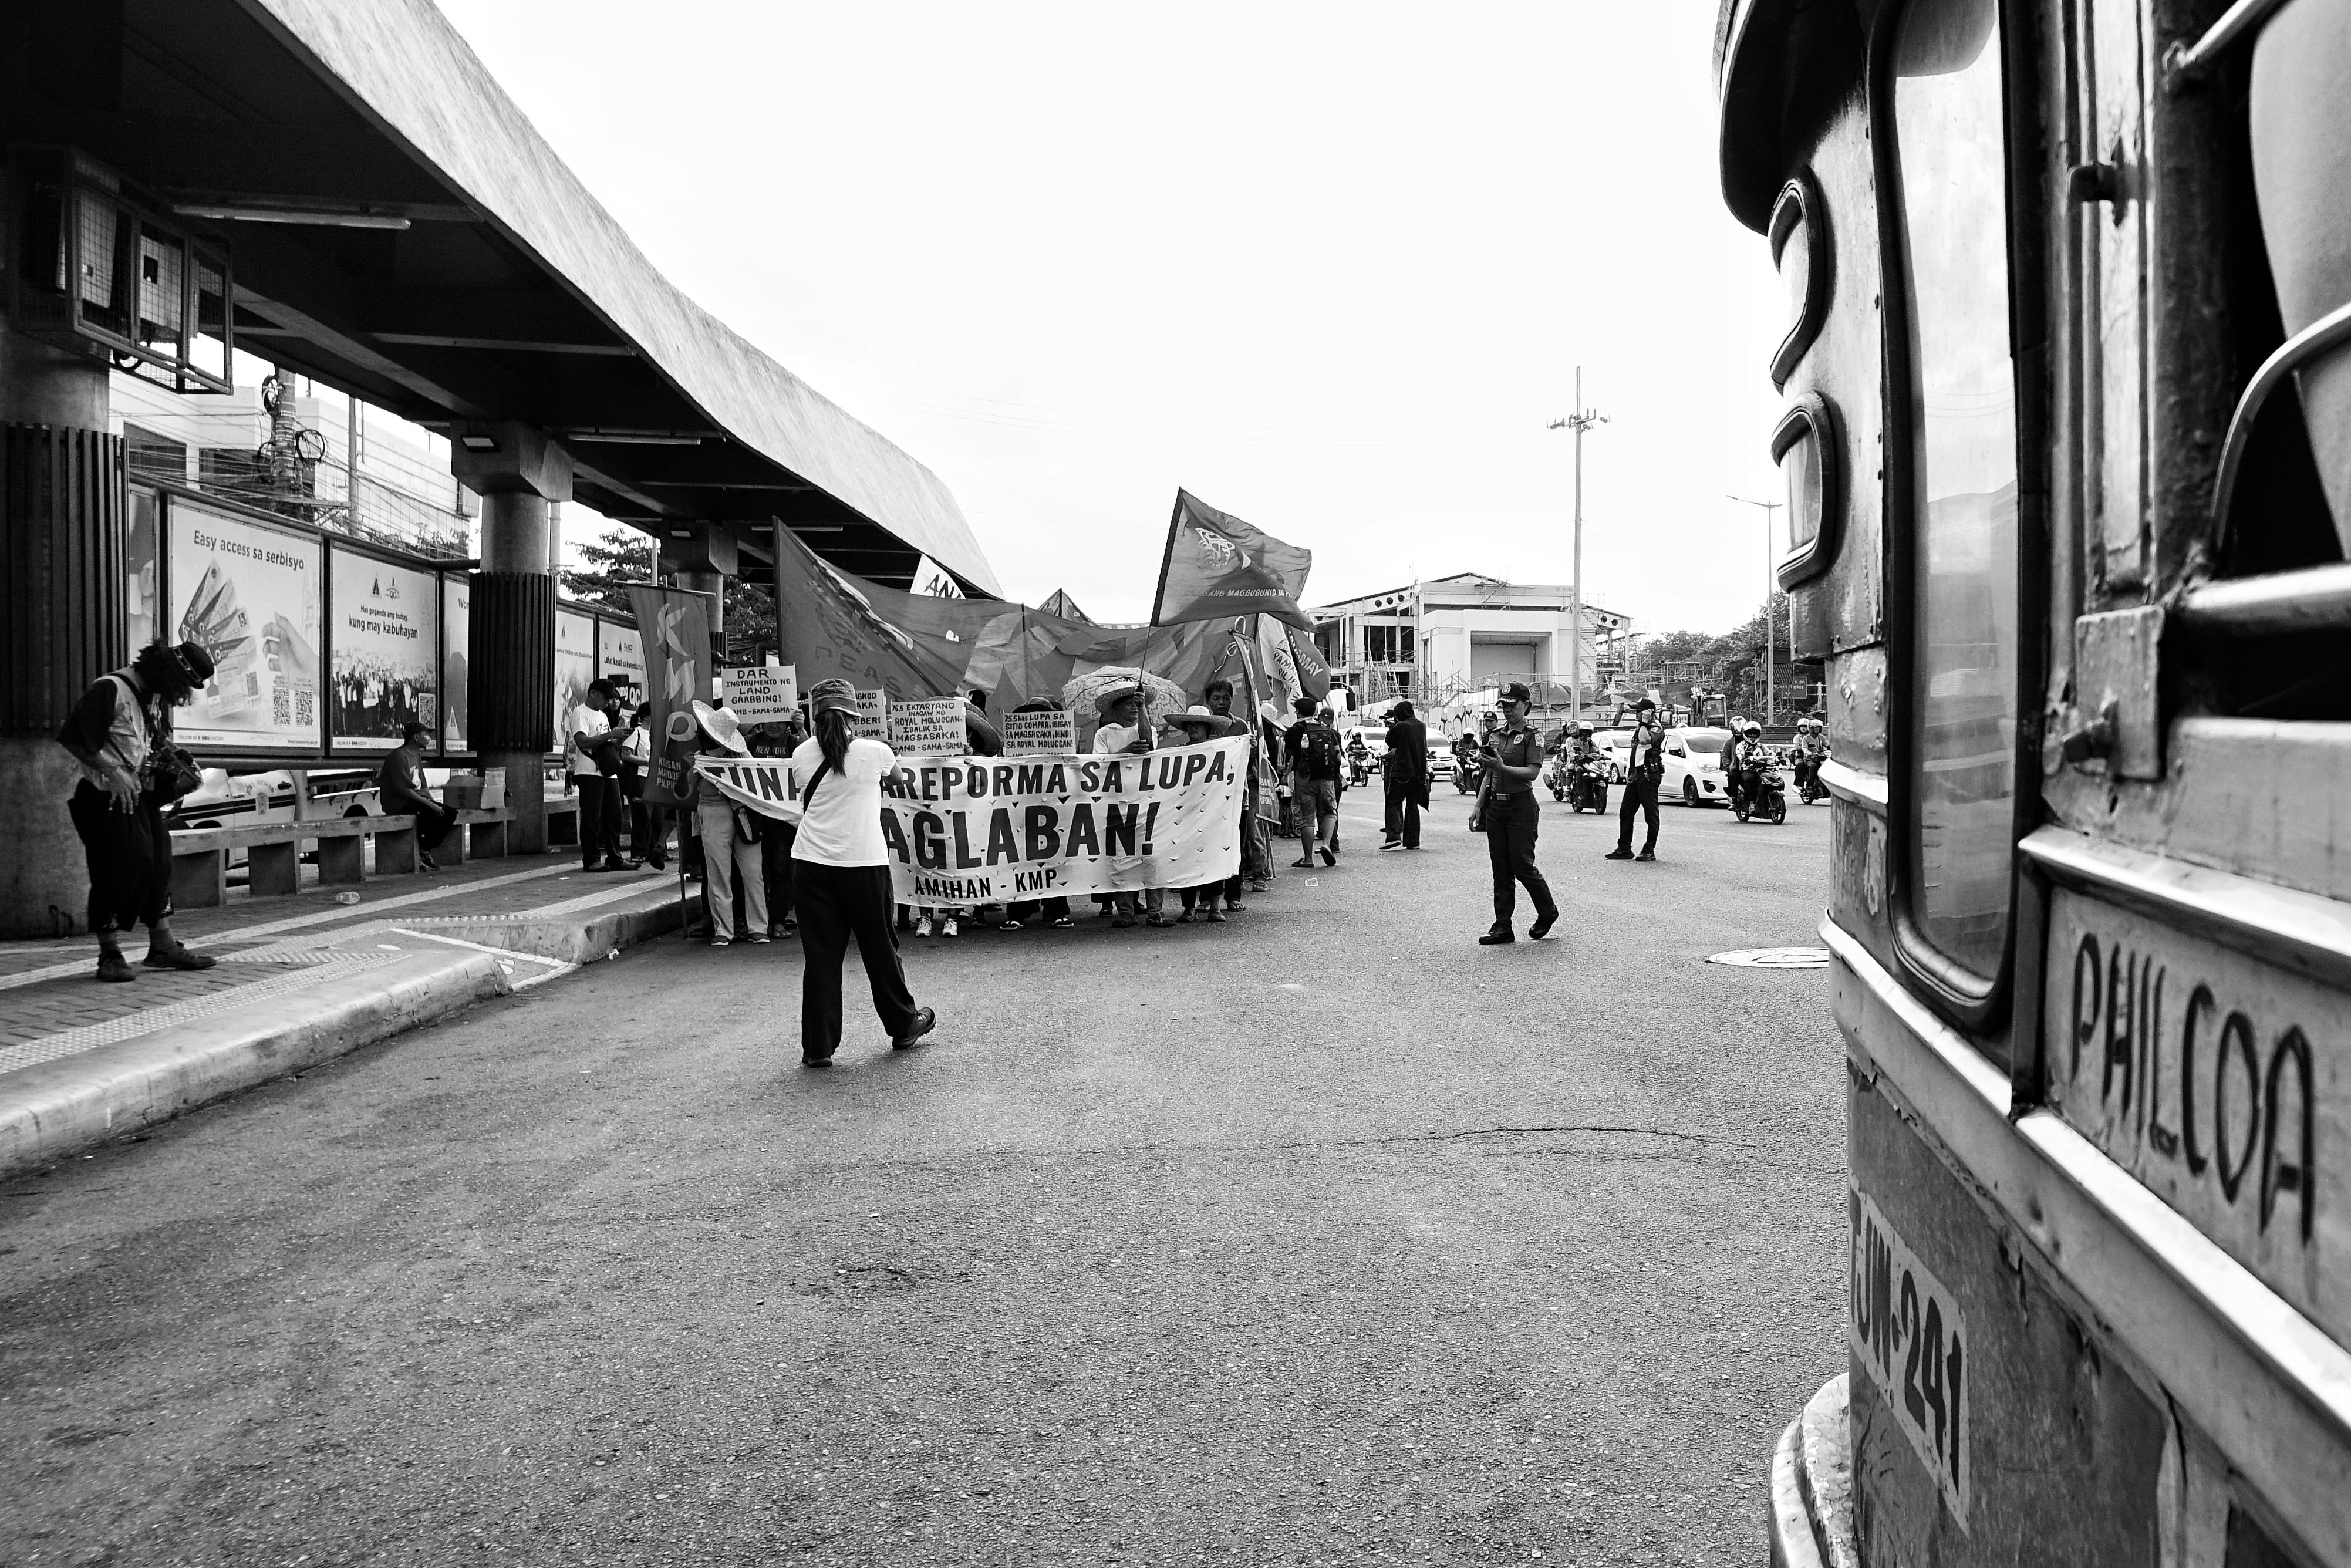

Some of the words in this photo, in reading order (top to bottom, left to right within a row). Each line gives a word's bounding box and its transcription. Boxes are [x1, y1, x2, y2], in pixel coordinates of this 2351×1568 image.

[194, 529, 217, 551] Easy
[220, 539, 250, 557] access
[253, 548, 263, 561] sa
[266, 551, 305, 571] serbisyo
[387, 611, 396, 620] ang
[349, 615, 365, 632] kung
[367, 620, 381, 635] may
[383, 621, 419, 640] kabuhayan
[737, 669, 770, 679] DAR
[726, 679, 777, 687] INSTRUMENTO
[740, 687, 771, 695] LAND
[731, 694, 782, 704] GRABBING!
[906, 702, 955, 711] EKTARYANG
[895, 717, 919, 727] ROYAL
[1030, 713, 1051, 721] LUPA
[903, 725, 930, 733] IBALIK
[1005, 722, 1023, 730] SITIO
[1024, 721, 1051, 729] COMPRA,
[1052, 720, 1072, 729] IBIGAY
[896, 730, 959, 743] MAGSASAKA!
[1005, 731, 1013, 739] SA
[1055, 730, 1071, 739] HINDI
[1007, 740, 1016, 749] SA
[1017, 740, 1036, 748] ROYAL
[1038, 739, 1074, 749] MOLUCCAN!
[755, 745, 770, 754] NEW
[772, 746, 787, 755] YORK
[1081, 760, 1125, 794] SA
[1138, 750, 1234, 791] LUPA,
[881, 801, 1161, 870] AGLABAN!
[914, 876, 991, 899] AMIHAN
[1014, 868, 1058, 893] KMP
[2070, 932, 2315, 1247] PHILCOA
